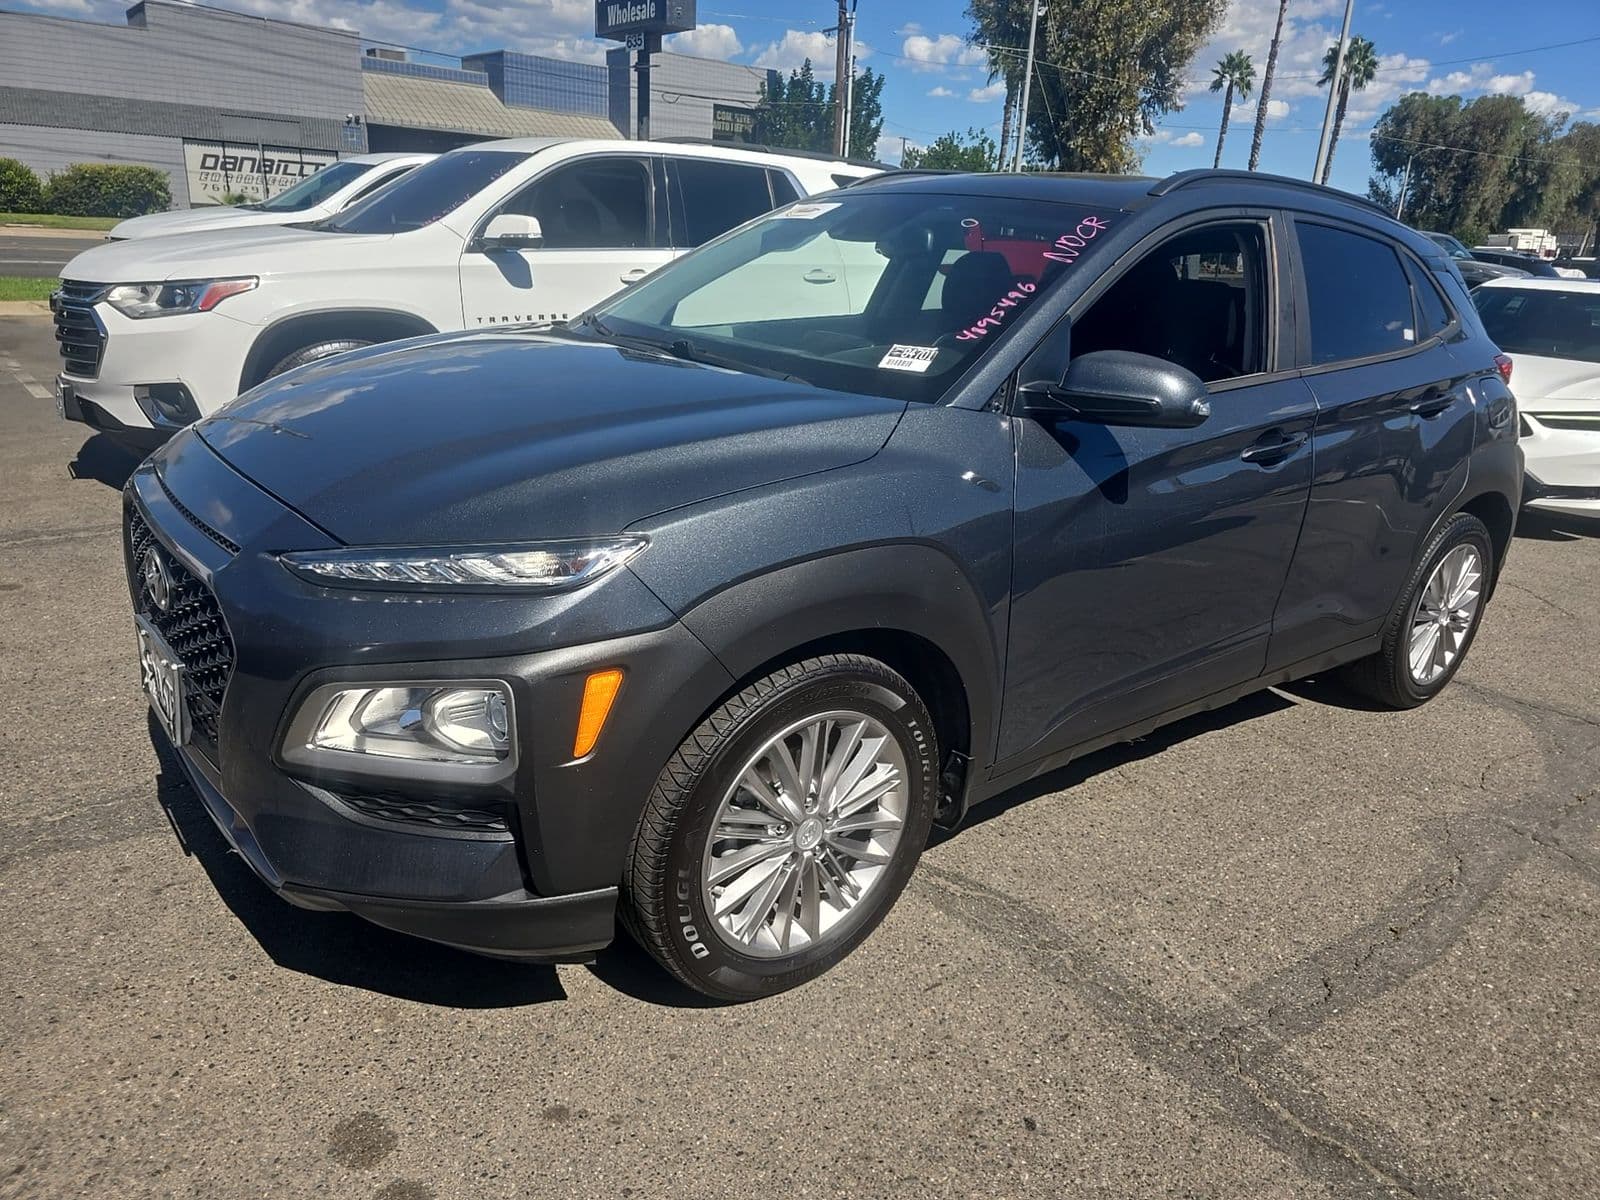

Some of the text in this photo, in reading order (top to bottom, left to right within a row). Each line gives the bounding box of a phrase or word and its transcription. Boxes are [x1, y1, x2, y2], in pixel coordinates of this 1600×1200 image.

[606, 0, 656, 27] Wholesale
[476, 313, 569, 324] TRAVERSE
[676, 862, 710, 960] DOUGL
